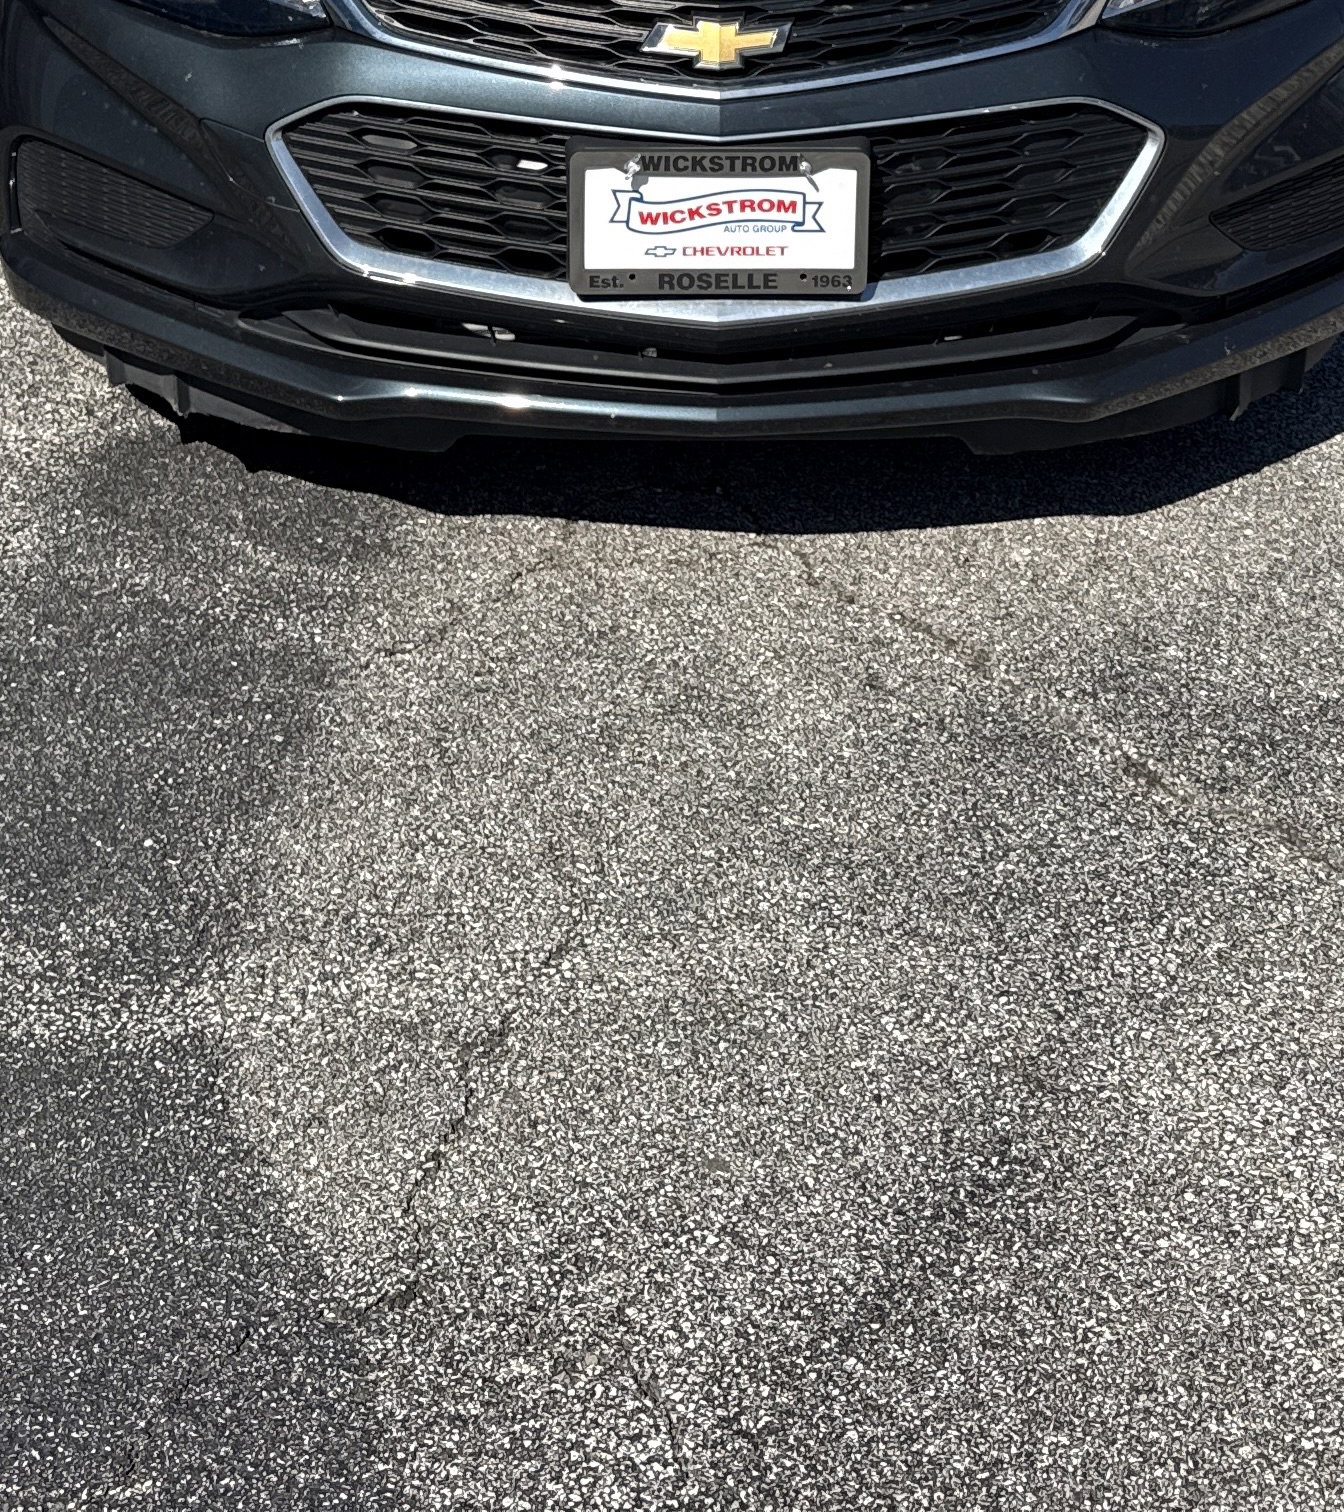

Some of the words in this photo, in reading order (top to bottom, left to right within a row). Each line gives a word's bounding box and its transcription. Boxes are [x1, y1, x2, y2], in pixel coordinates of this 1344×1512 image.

[641, 155, 798, 173] WICKSTROM
[638, 199, 798, 226] WICKSTROM
[723, 224, 750, 233] AUTO
[752, 224, 787, 233] GROUP
[682, 246, 789, 257] CHEVROLET
[588, 275, 624, 289] Est.
[658, 273, 778, 291] ROSELLE
[811, 275, 853, 289] 1963
